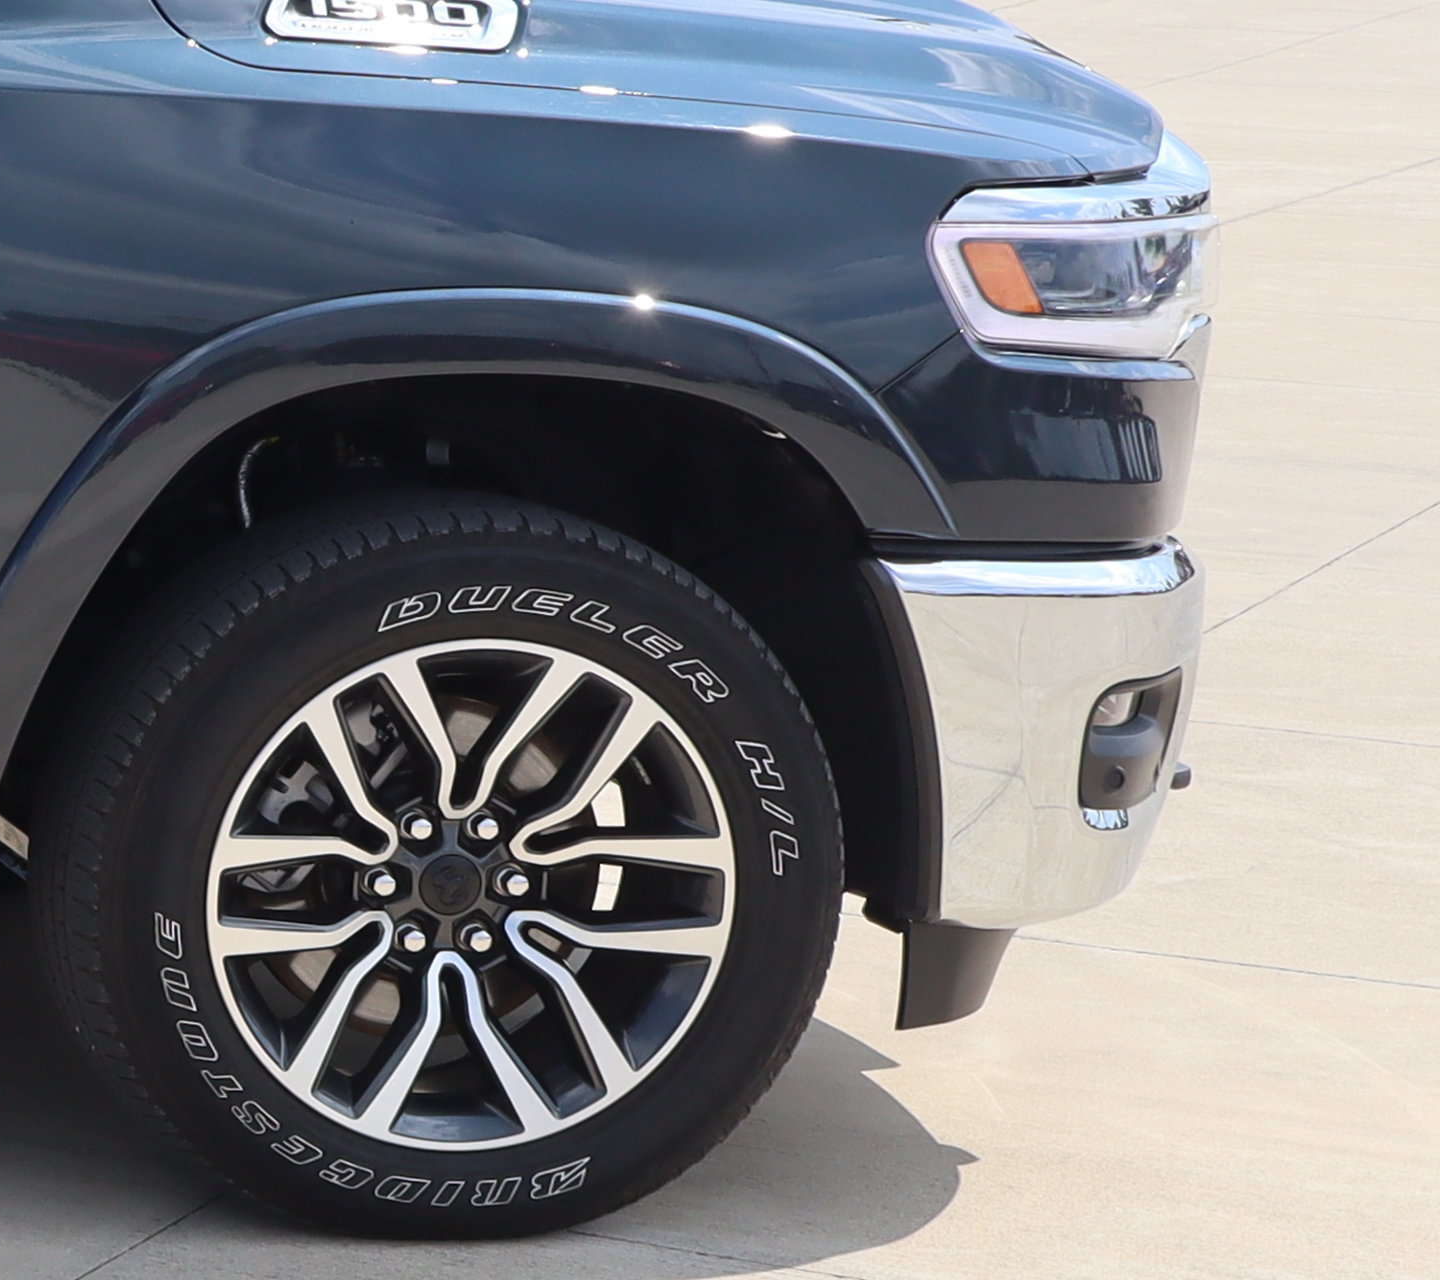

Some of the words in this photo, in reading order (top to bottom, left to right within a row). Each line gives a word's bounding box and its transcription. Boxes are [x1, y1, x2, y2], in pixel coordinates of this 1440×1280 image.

[378, 584, 730, 704] DUELER
[735, 739, 801, 877] H/L
[153, 912, 592, 1209] BRIDGESTONE
